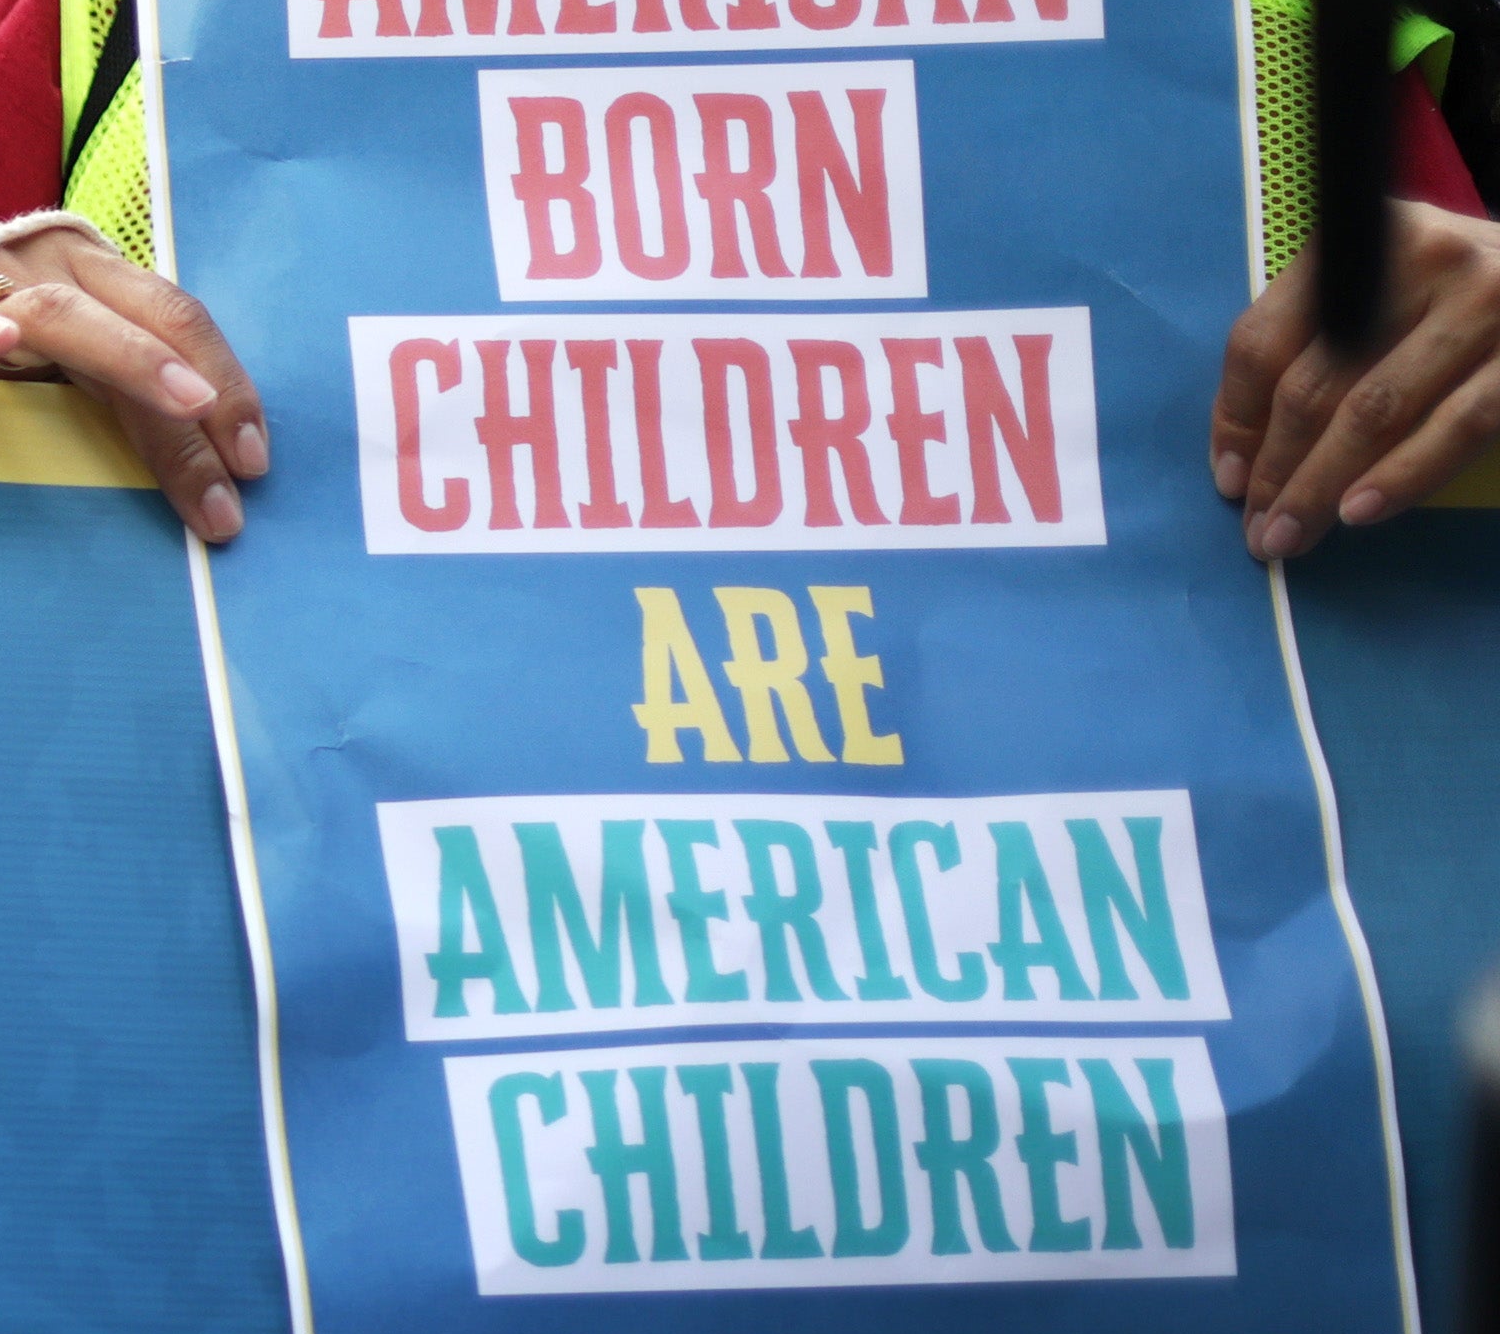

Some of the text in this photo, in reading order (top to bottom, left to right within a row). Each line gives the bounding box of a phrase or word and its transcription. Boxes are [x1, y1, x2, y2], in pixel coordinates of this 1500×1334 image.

[508, 88, 894, 281] BORN
[388, 334, 1063, 532] CHILDREN
[632, 585, 904, 766] ARE
[426, 816, 1192, 1020] AMERICAN
[488, 1056, 1197, 1270] CHILDREN
